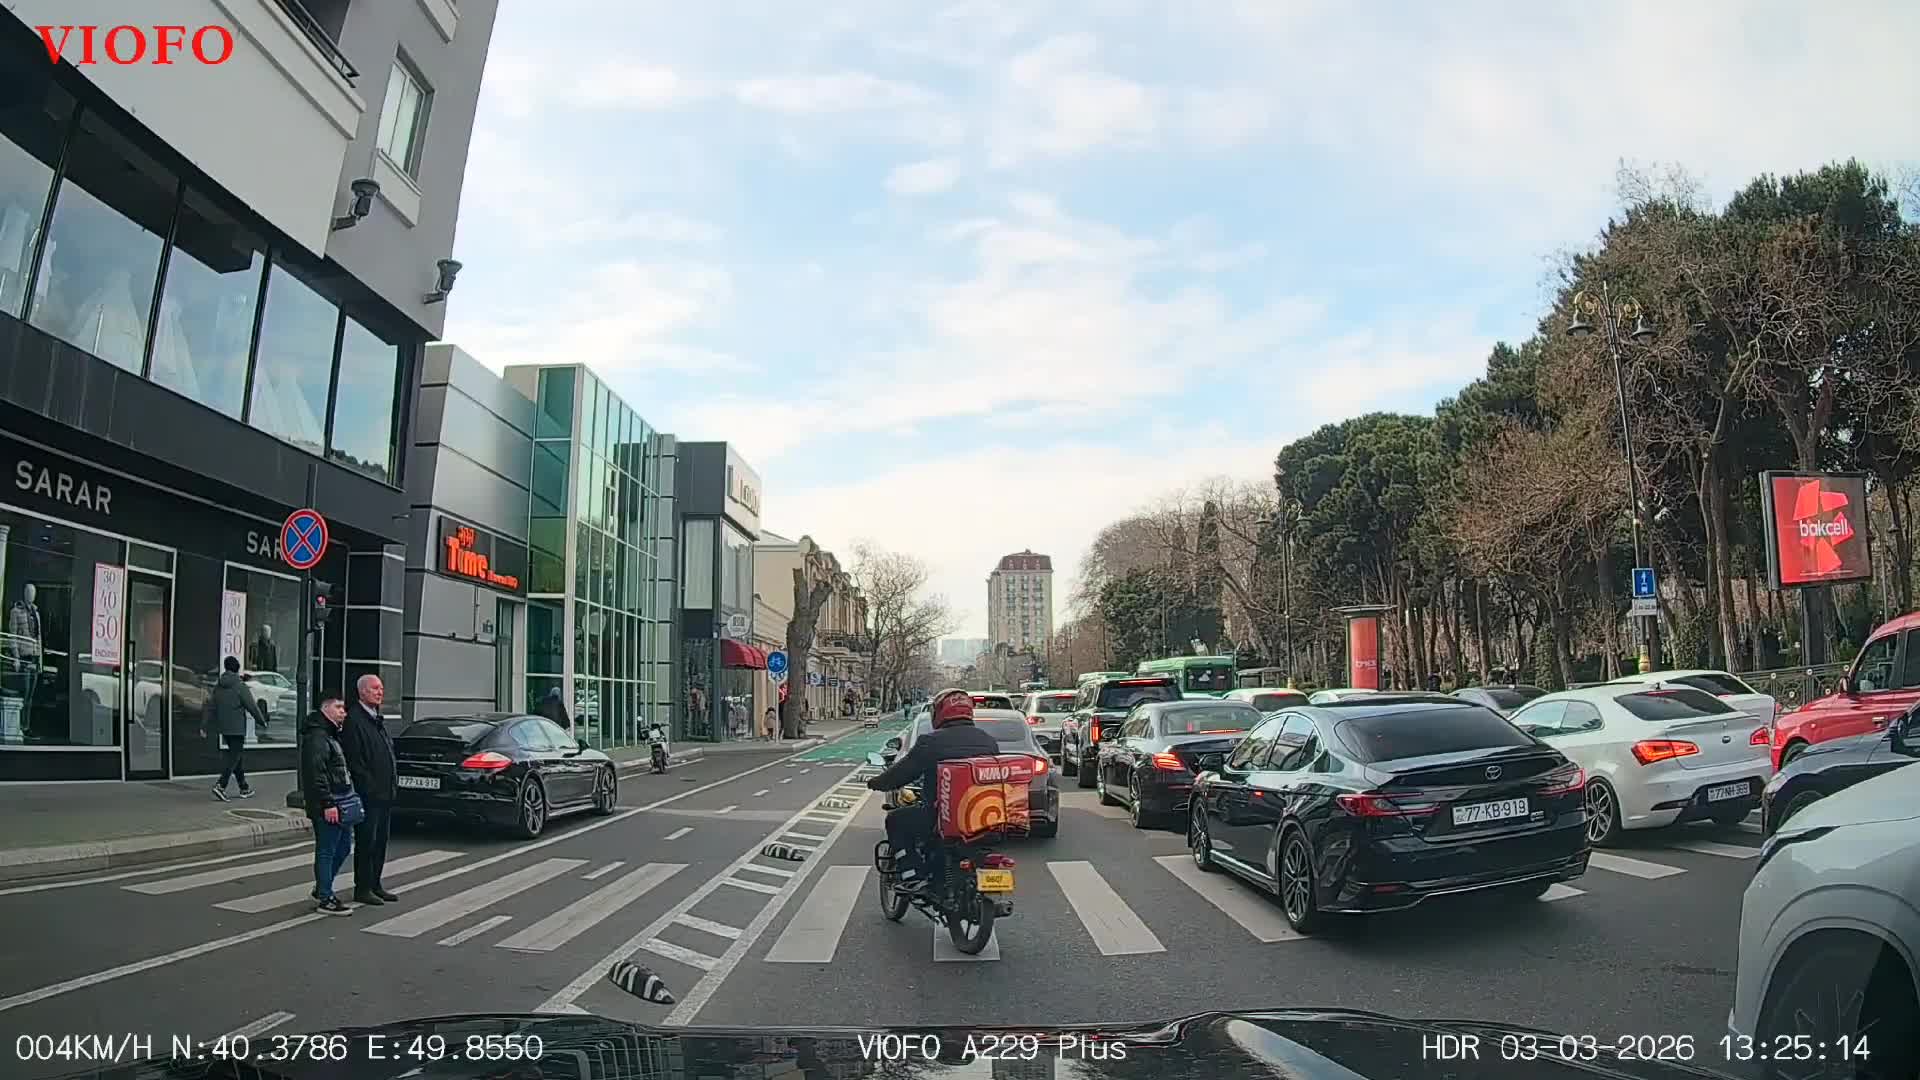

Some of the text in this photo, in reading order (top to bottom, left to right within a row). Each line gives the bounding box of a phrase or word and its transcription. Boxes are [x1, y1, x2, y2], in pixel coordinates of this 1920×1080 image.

[15, 460, 112, 515] SARAR
[1800, 520, 1848, 537] bakcell
[446, 536, 488, 580] Time
[96, 614, 118, 641] 50
[941, 767, 952, 823] YANGO
